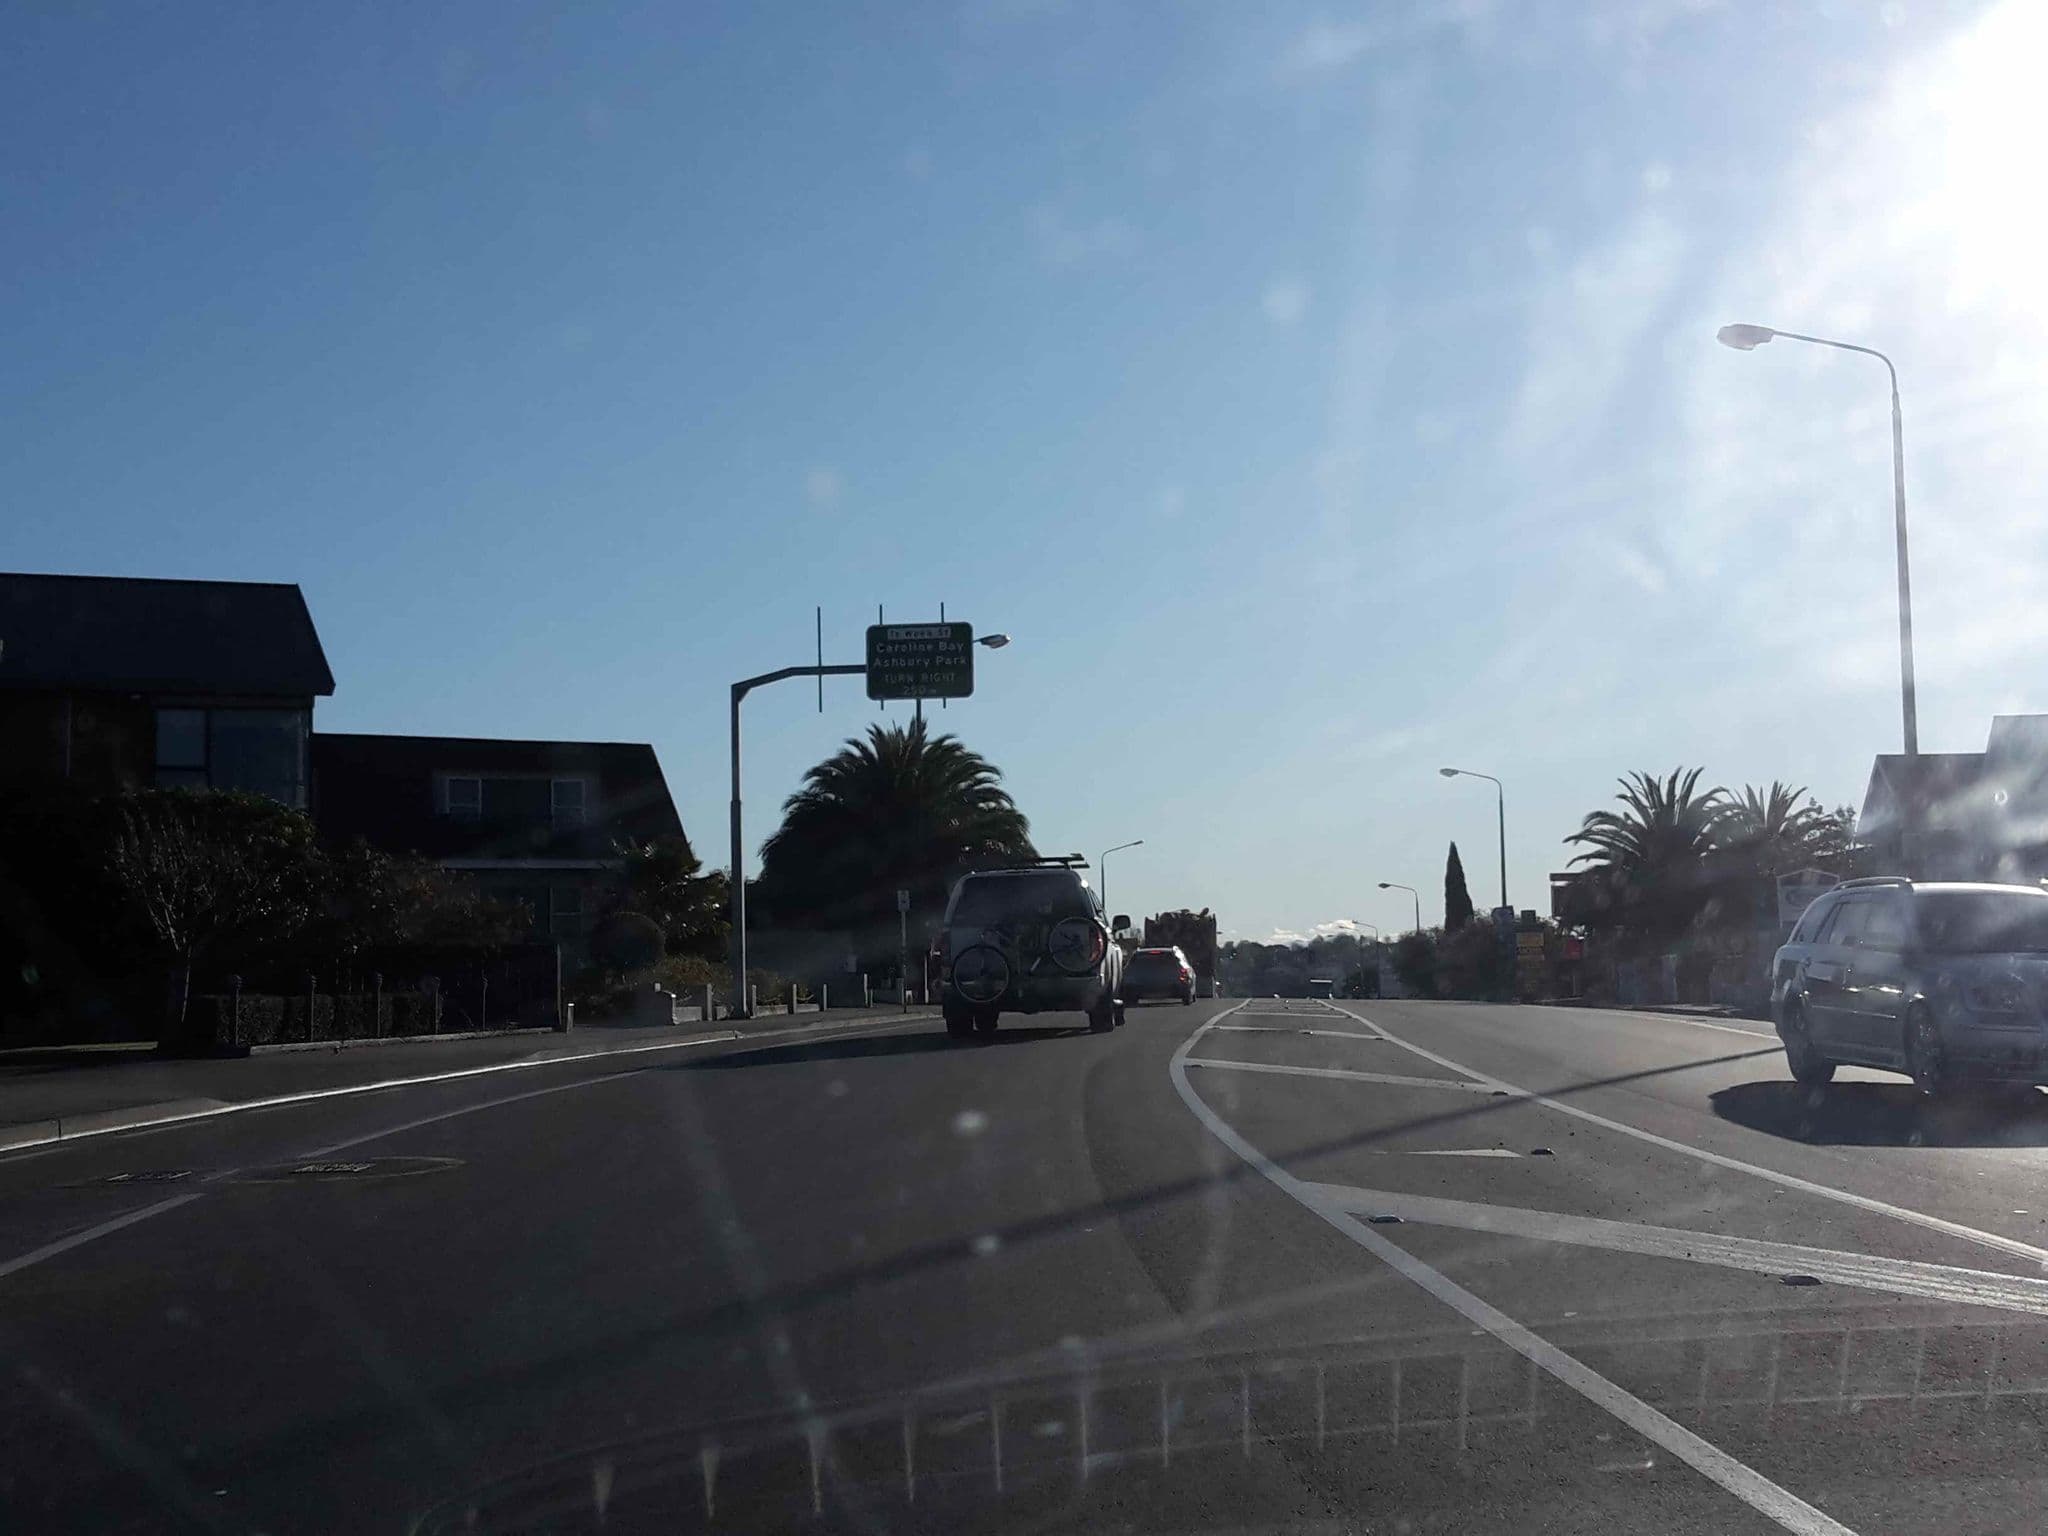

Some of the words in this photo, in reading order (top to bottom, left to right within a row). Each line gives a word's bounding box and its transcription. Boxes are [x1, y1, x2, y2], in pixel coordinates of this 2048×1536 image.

[876, 641, 933, 653] Caroline
[939, 641, 965, 653] Bay
[873, 656, 931, 669] Ashbury
[936, 655, 968, 666] Park
[884, 673, 914, 683] TURN
[921, 671, 956, 682] RIGHT
